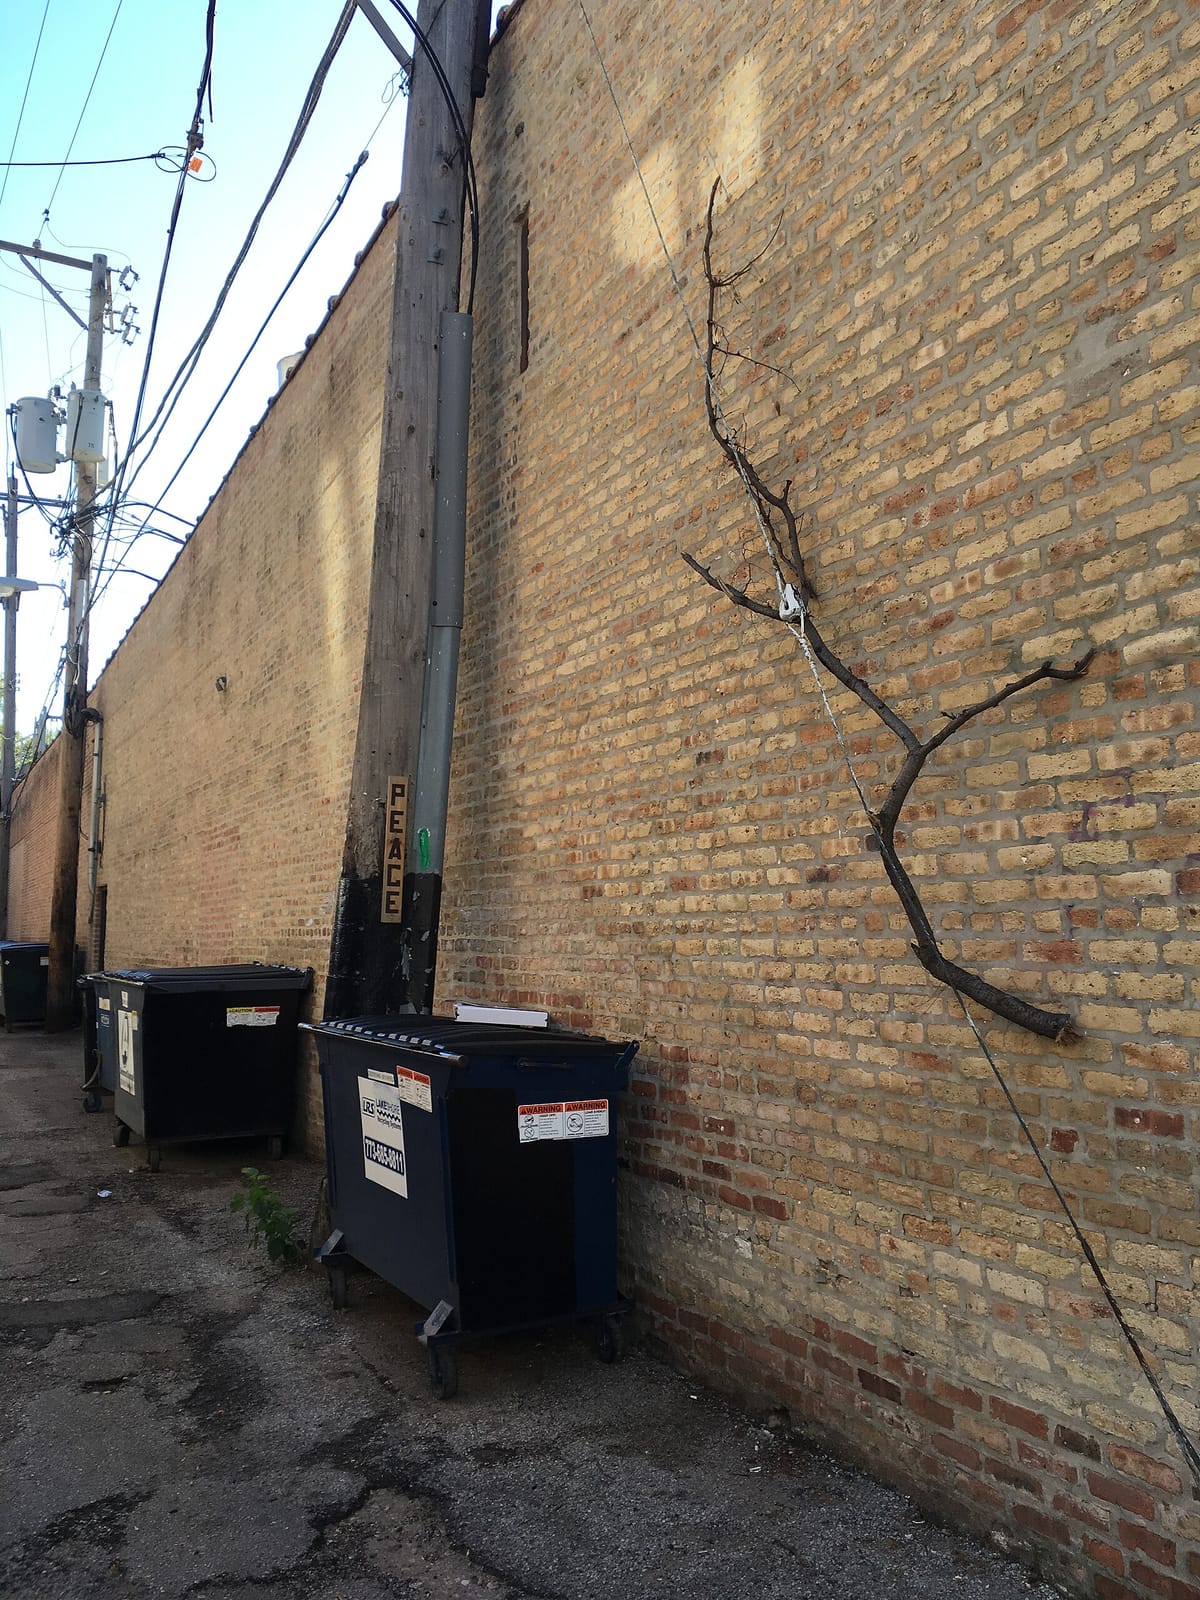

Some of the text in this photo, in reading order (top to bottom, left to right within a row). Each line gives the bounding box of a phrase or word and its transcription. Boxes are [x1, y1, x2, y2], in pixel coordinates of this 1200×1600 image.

[385, 783, 406, 914] PEACE
[526, 1105, 561, 1114] WARNING
[571, 1101, 606, 1111] WARNING
